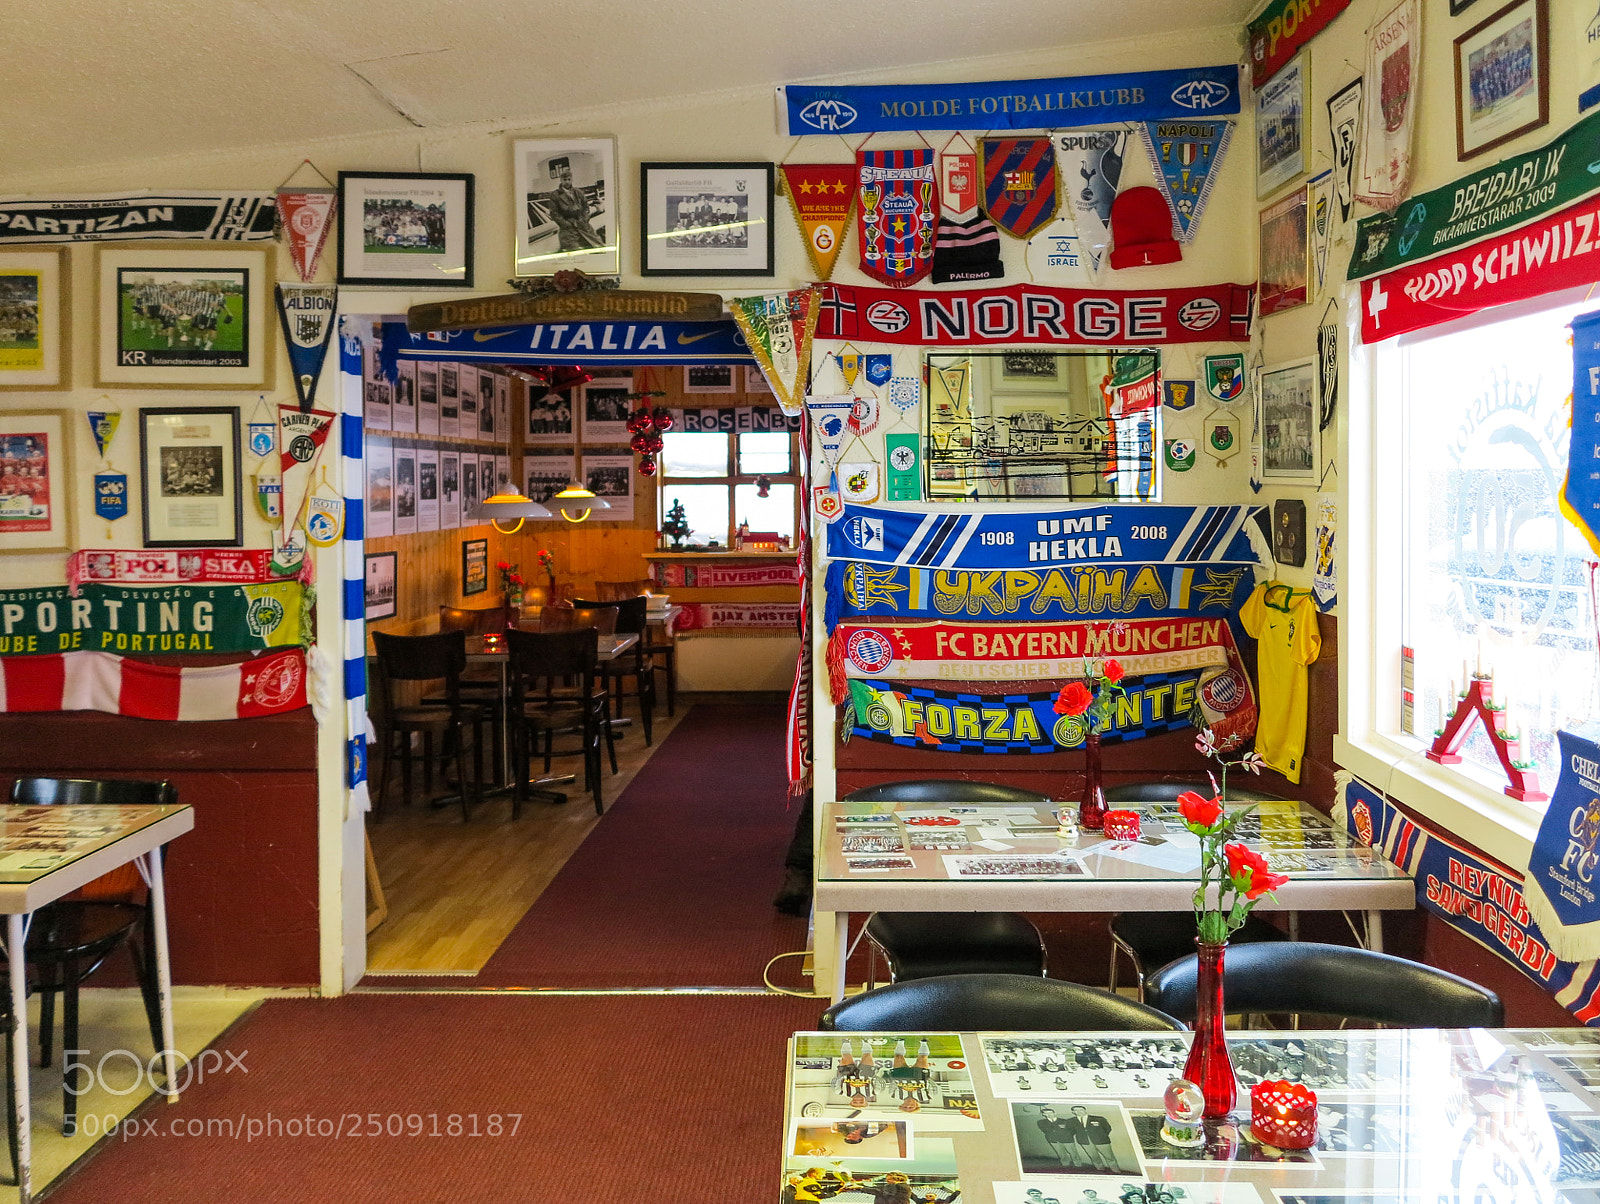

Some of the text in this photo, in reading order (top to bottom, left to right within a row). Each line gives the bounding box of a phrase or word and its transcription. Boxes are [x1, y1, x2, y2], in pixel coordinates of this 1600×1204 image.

[1267, 0, 1320, 56] POR
[880, 87, 1146, 118] MOLDE FOTBALLKLUBB
[1157, 124, 1216, 138] NAPOLI
[1061, 136, 1112, 151] SPURS
[860, 164, 935, 184] STEAUA
[802, 214, 846, 222] CHAMPIONS
[1432, 182, 1557, 246] BIKARMEISTARAR 2009
[894, 260, 905, 268] 22
[1047, 258, 1079, 267] ISRAEL
[949, 271, 990, 280] PALERMO
[1403, 262, 1467, 303] HOPP
[285, 297, 333, 310] ALBION
[919, 292, 1168, 340] NORGE
[530, 324, 667, 350] ITALIA
[122, 350, 147, 365] KR
[219, 358, 242, 366] 2003
[101, 496, 122, 505] FIFA
[853, 519, 861, 546] HEKLA
[979, 523, 1168, 546] 1908 2008
[1036, 514, 1113, 536] UMF
[1028, 535, 1123, 562] HEKLA
[124, 558, 175, 574] POL
[204, 558, 257, 575] SKA
[713, 569, 796, 582] LIVERPOOL
[121, 586, 191, 600] DEVOÇÃO
[209, 590, 216, 598] E
[711, 611, 743, 622] AJAX
[59, 631, 82, 650] DE
[101, 631, 213, 652] PORTUGAL
[935, 631, 967, 657] FC
[972, 630, 1078, 658] BAYERN
[938, 661, 1052, 677] DEUTSCHER
[900, 698, 1041, 742] FORZA
[1449, 856, 1530, 928] REYNIR
[1560, 884, 1581, 907] London
